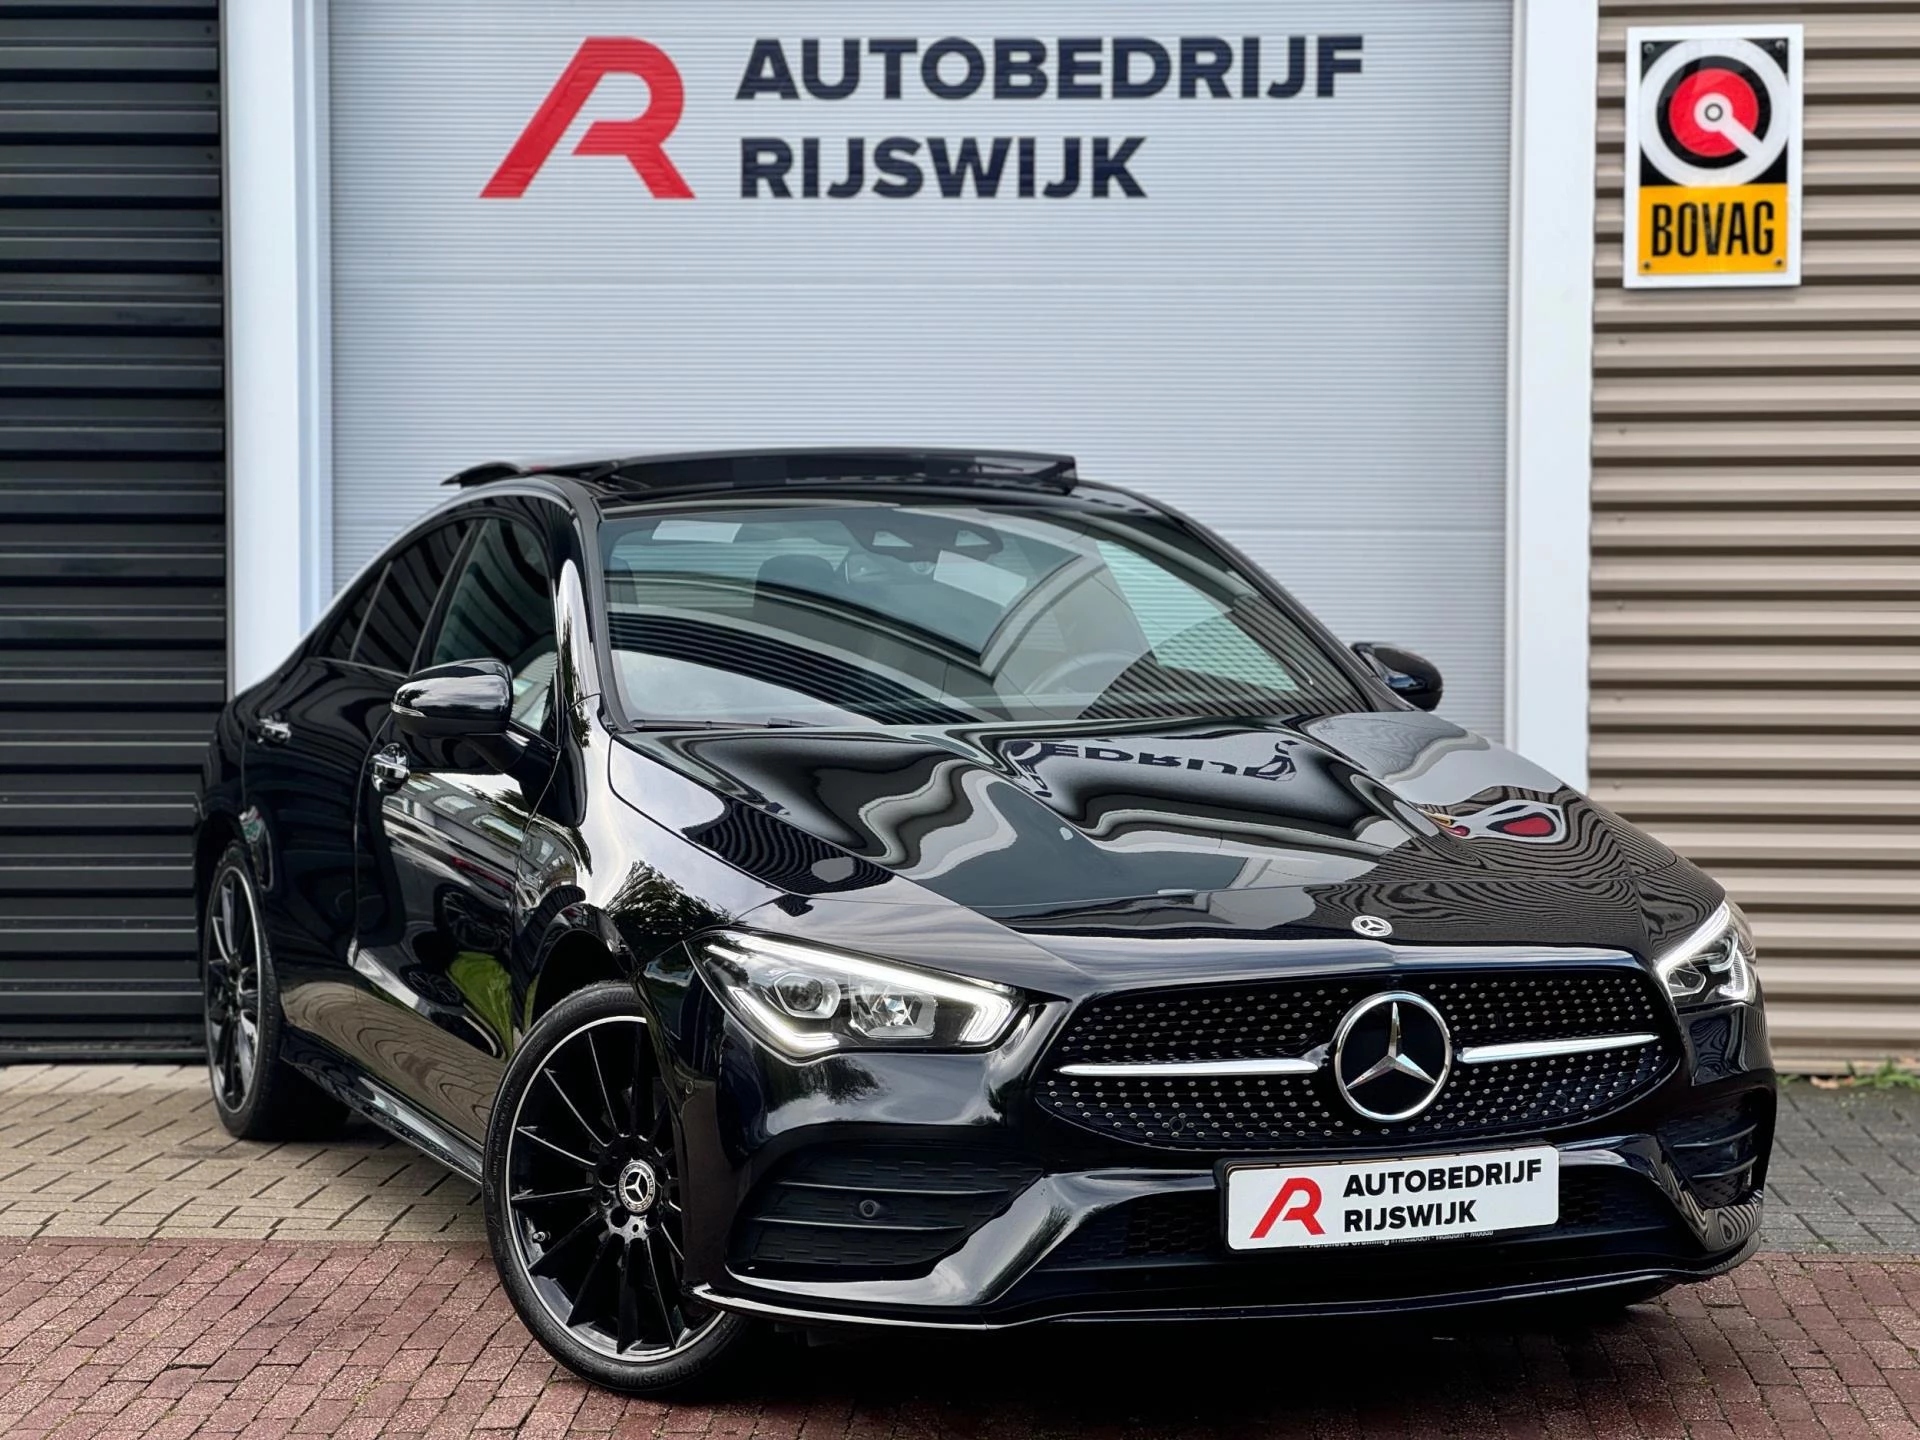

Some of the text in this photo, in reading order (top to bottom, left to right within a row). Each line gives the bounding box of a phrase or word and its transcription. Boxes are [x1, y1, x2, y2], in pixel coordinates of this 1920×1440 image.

[736, 36, 1362, 100] AUTOBEDRIJF
[742, 138, 1145, 198] RIJSWIJK
[1651, 200, 1774, 258] BOVAG
[1343, 1159, 1541, 1197] AUTOBEDRIJF
[1344, 1200, 1477, 1233] RIJSWIJK
